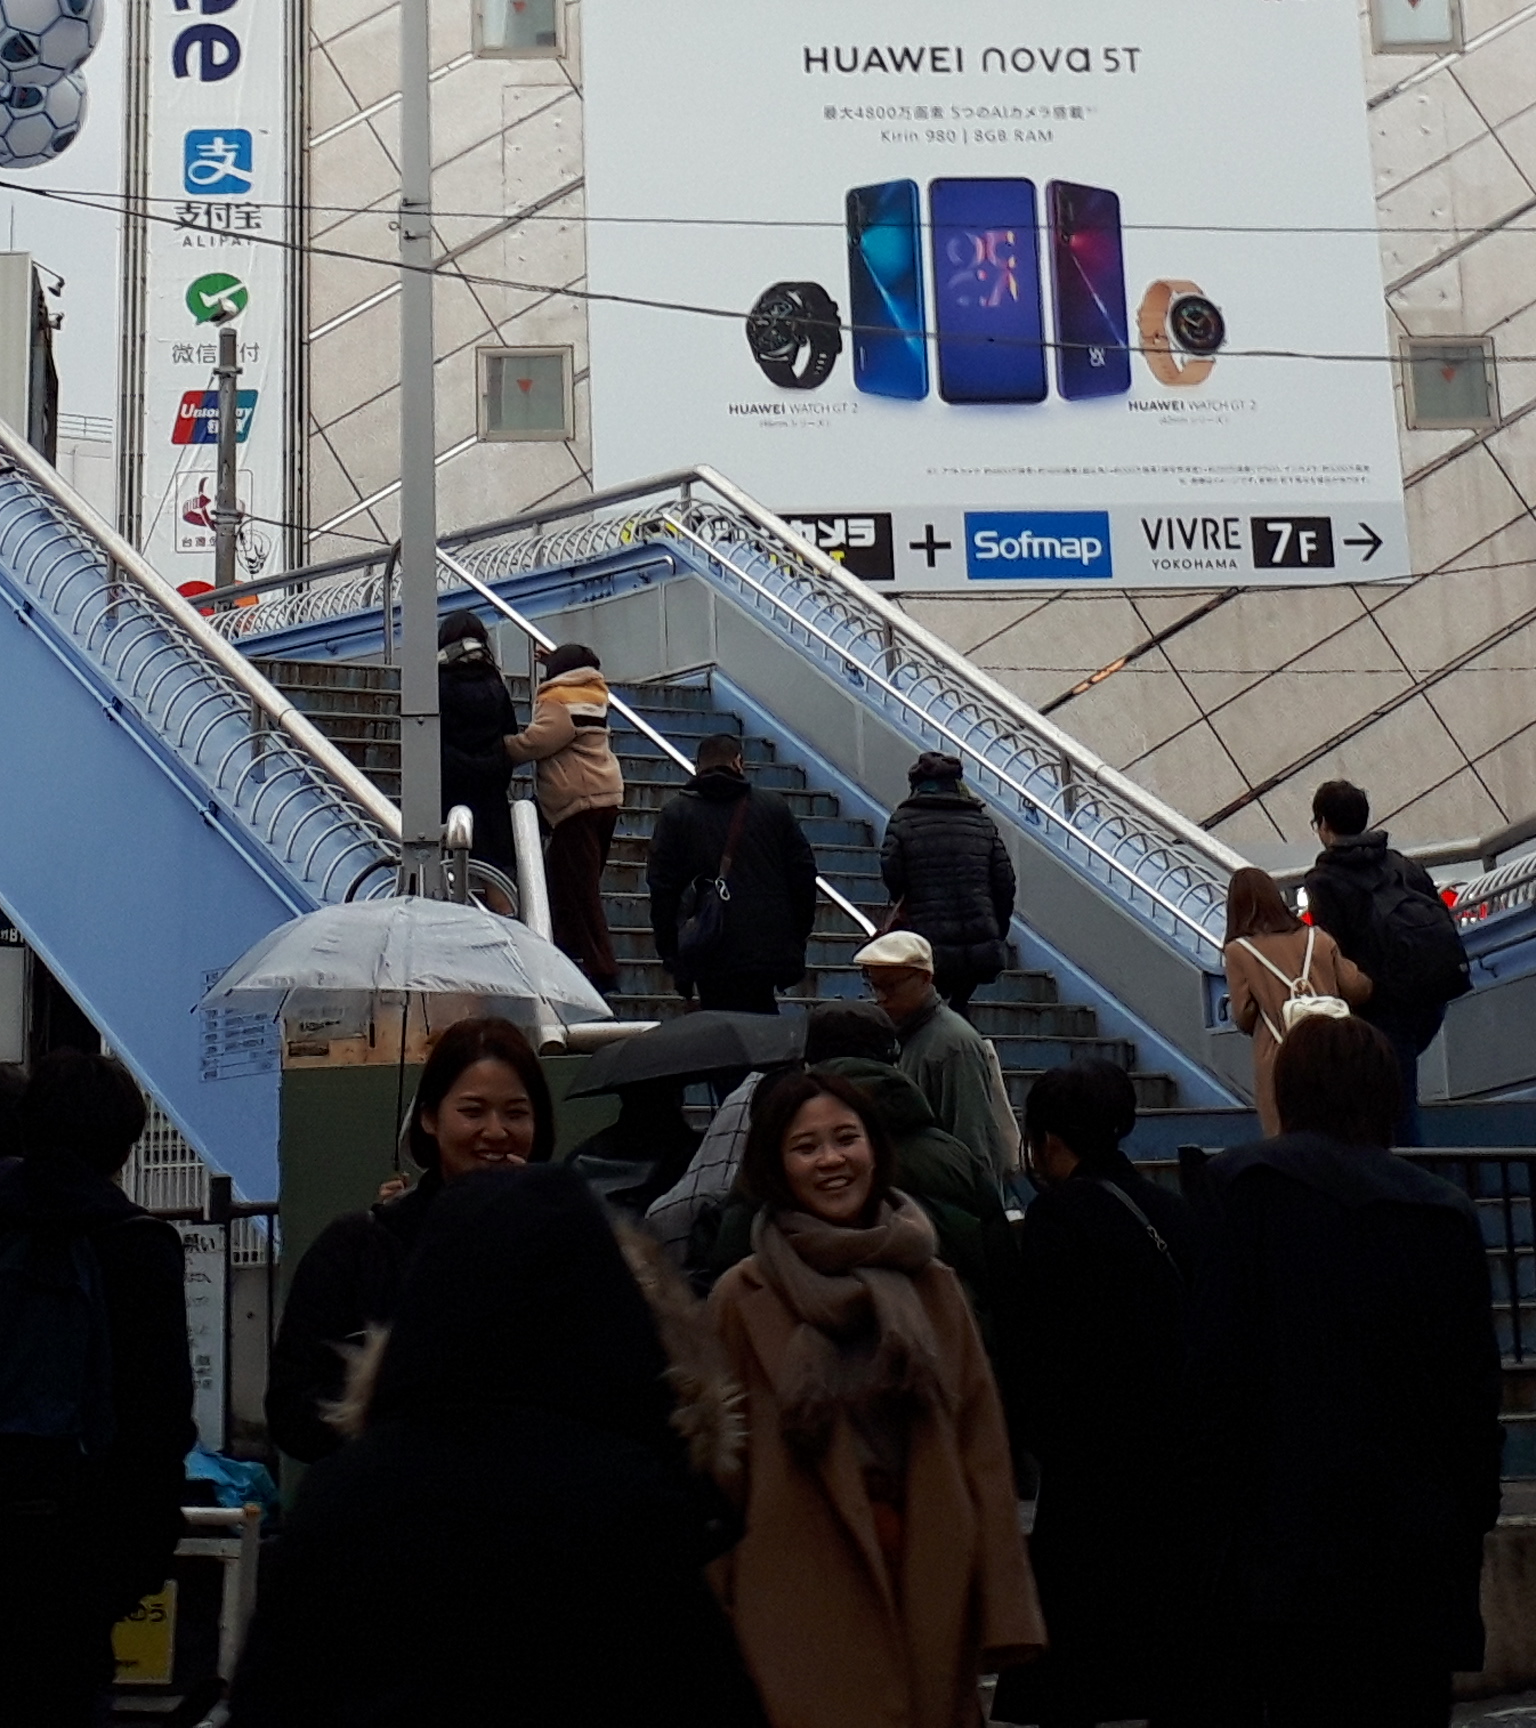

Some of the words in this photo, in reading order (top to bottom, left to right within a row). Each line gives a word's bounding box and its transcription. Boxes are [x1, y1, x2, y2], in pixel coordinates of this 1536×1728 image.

[803, 45, 964, 74] HUAWEI
[981, 46, 1091, 74] nova
[1104, 46, 1143, 74] 5T
[880, 129, 919, 143] Kirin
[925, 129, 957, 143] 980
[974, 129, 1008, 143] 8GB
[1013, 129, 1054, 143] RAM
[174, 201, 263, 231] 支付宝
[171, 342, 261, 364] 微信付
[729, 402, 786, 415] HUAWEI
[1128, 399, 1185, 412] HUAWEI
[1141, 517, 1243, 552] VIVRE
[1266, 522, 1319, 565] 7F
[973, 529, 1103, 566] Sofmap
[1151, 558, 1239, 571] YOKOHAMA
